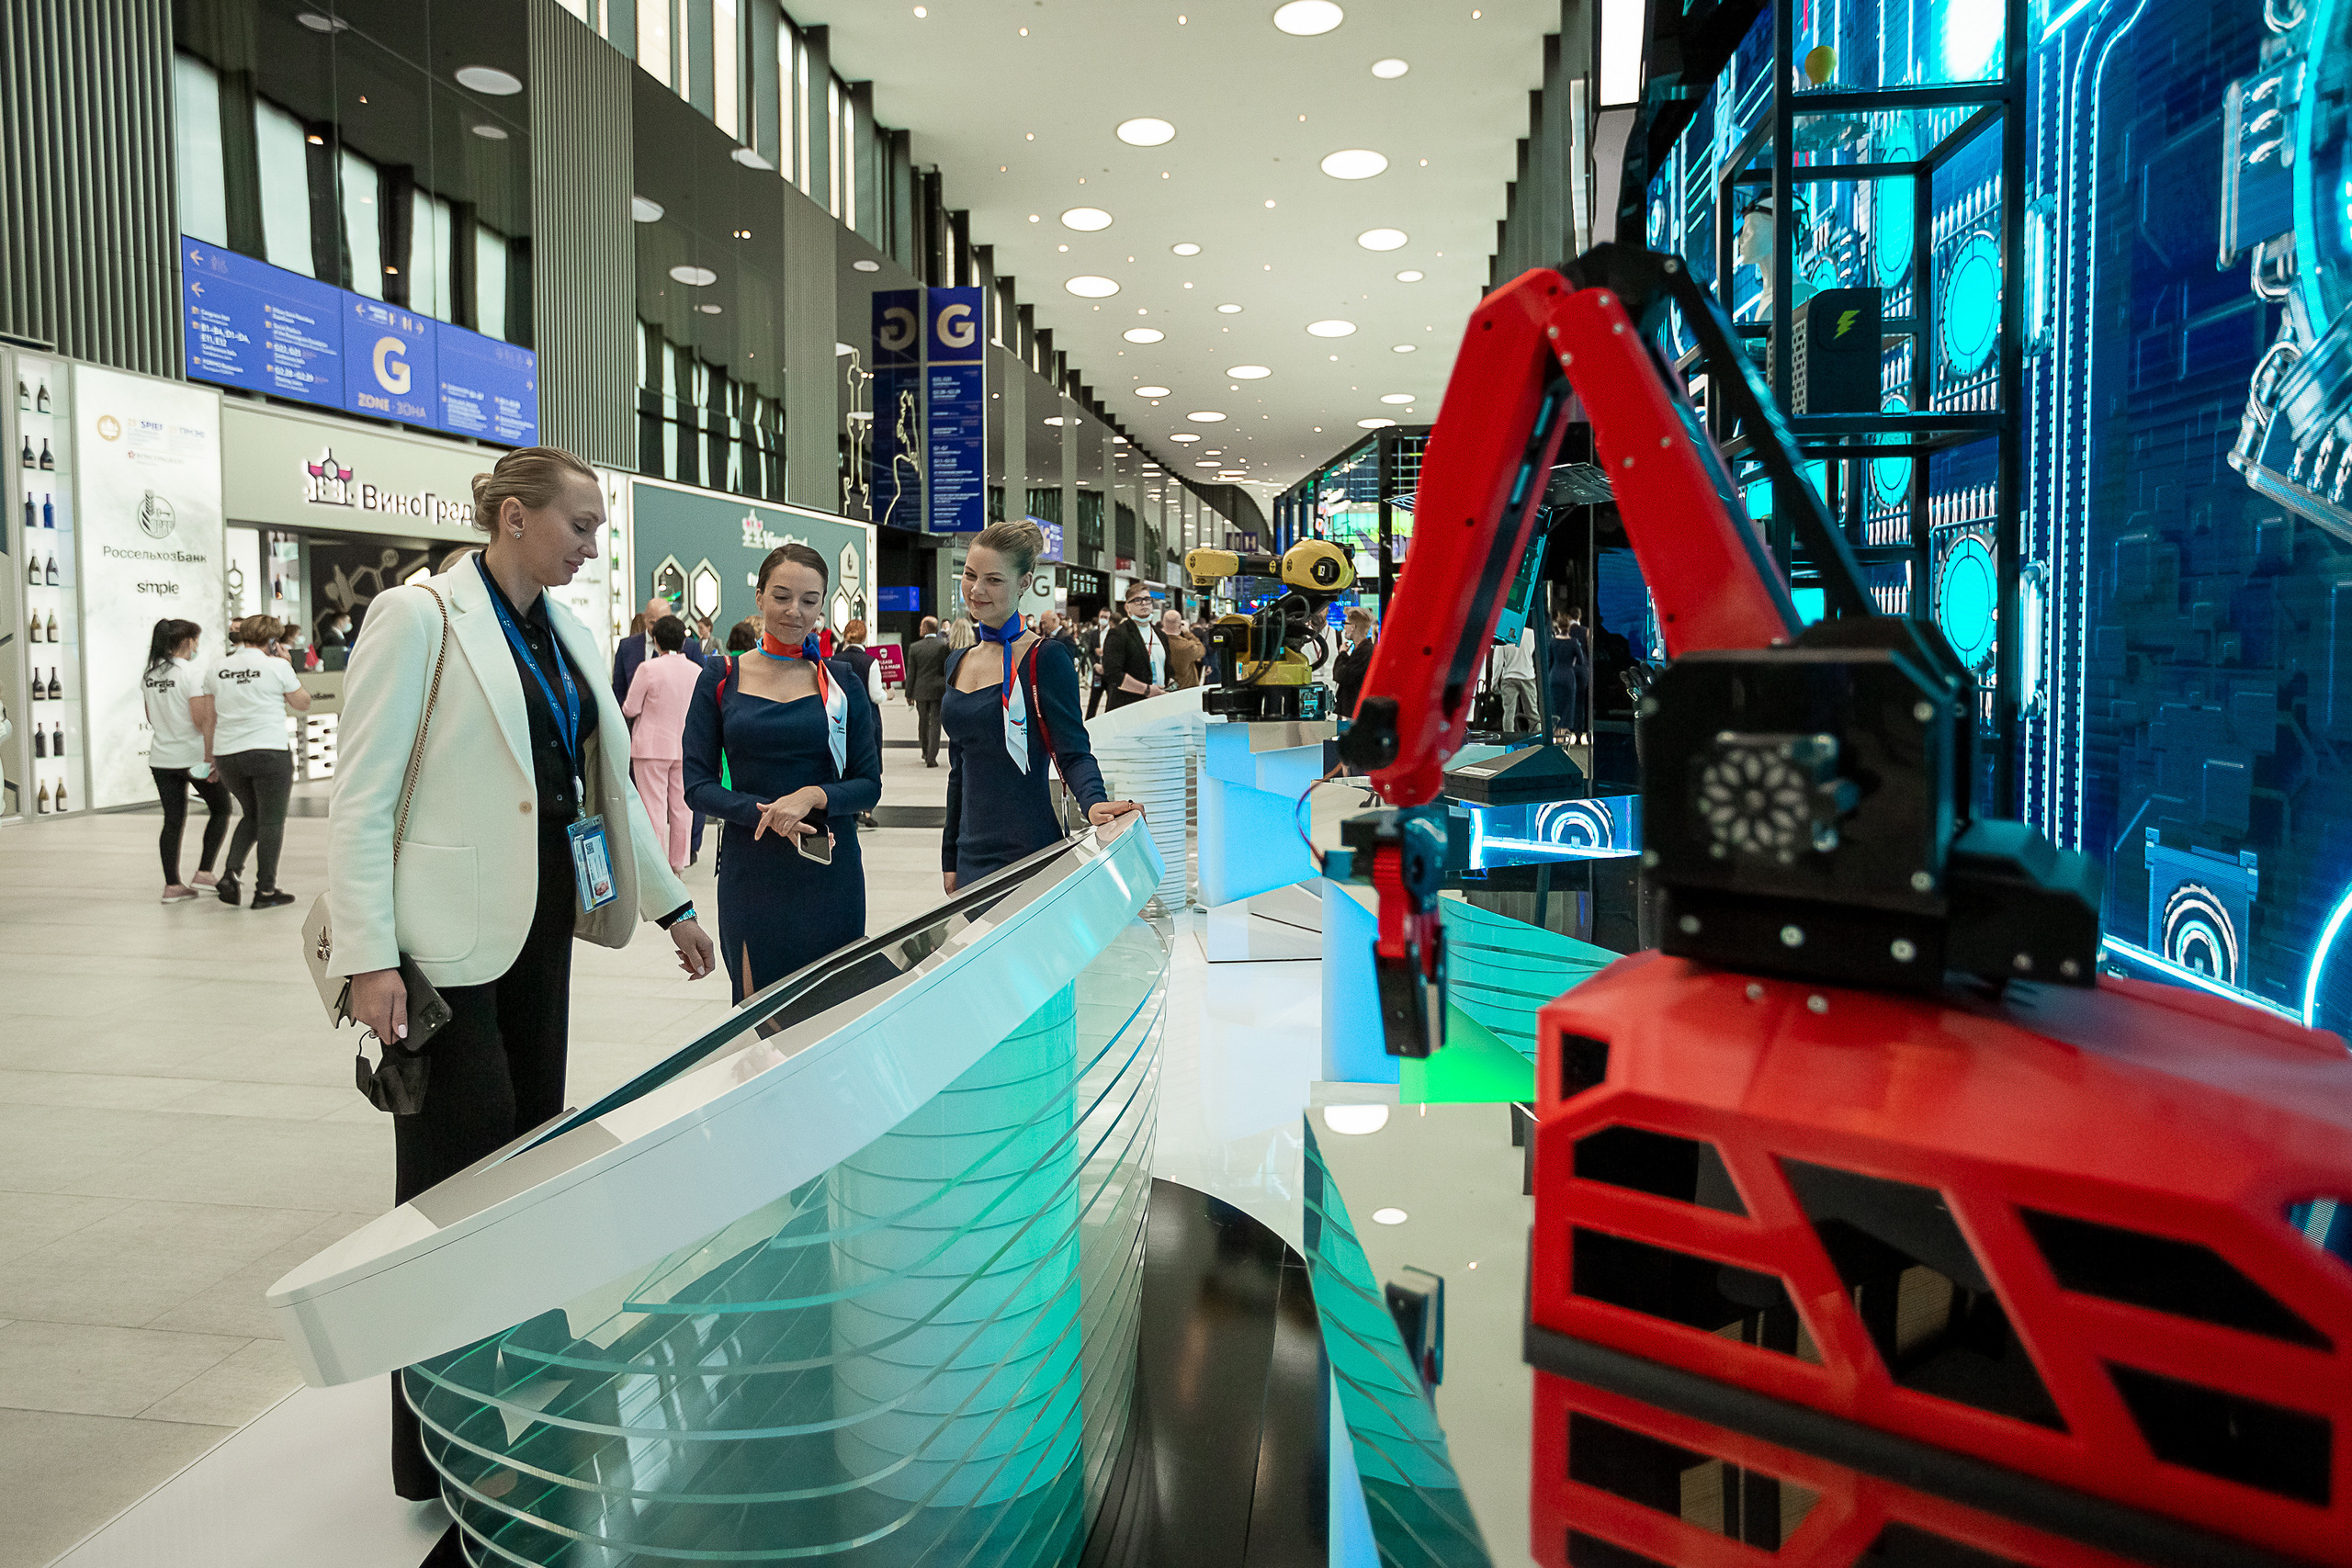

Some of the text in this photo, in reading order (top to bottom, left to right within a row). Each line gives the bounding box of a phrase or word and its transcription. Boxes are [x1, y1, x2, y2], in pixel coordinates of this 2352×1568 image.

[936, 303, 976, 349] G
[373, 336, 412, 395] G
[358, 392, 390, 412] ZONE
[103, 545, 208, 563] РоссельхозБанк
[137, 579, 180, 597] simple
[1032, 575, 1051, 598] G
[219, 669, 262, 680] Grata
